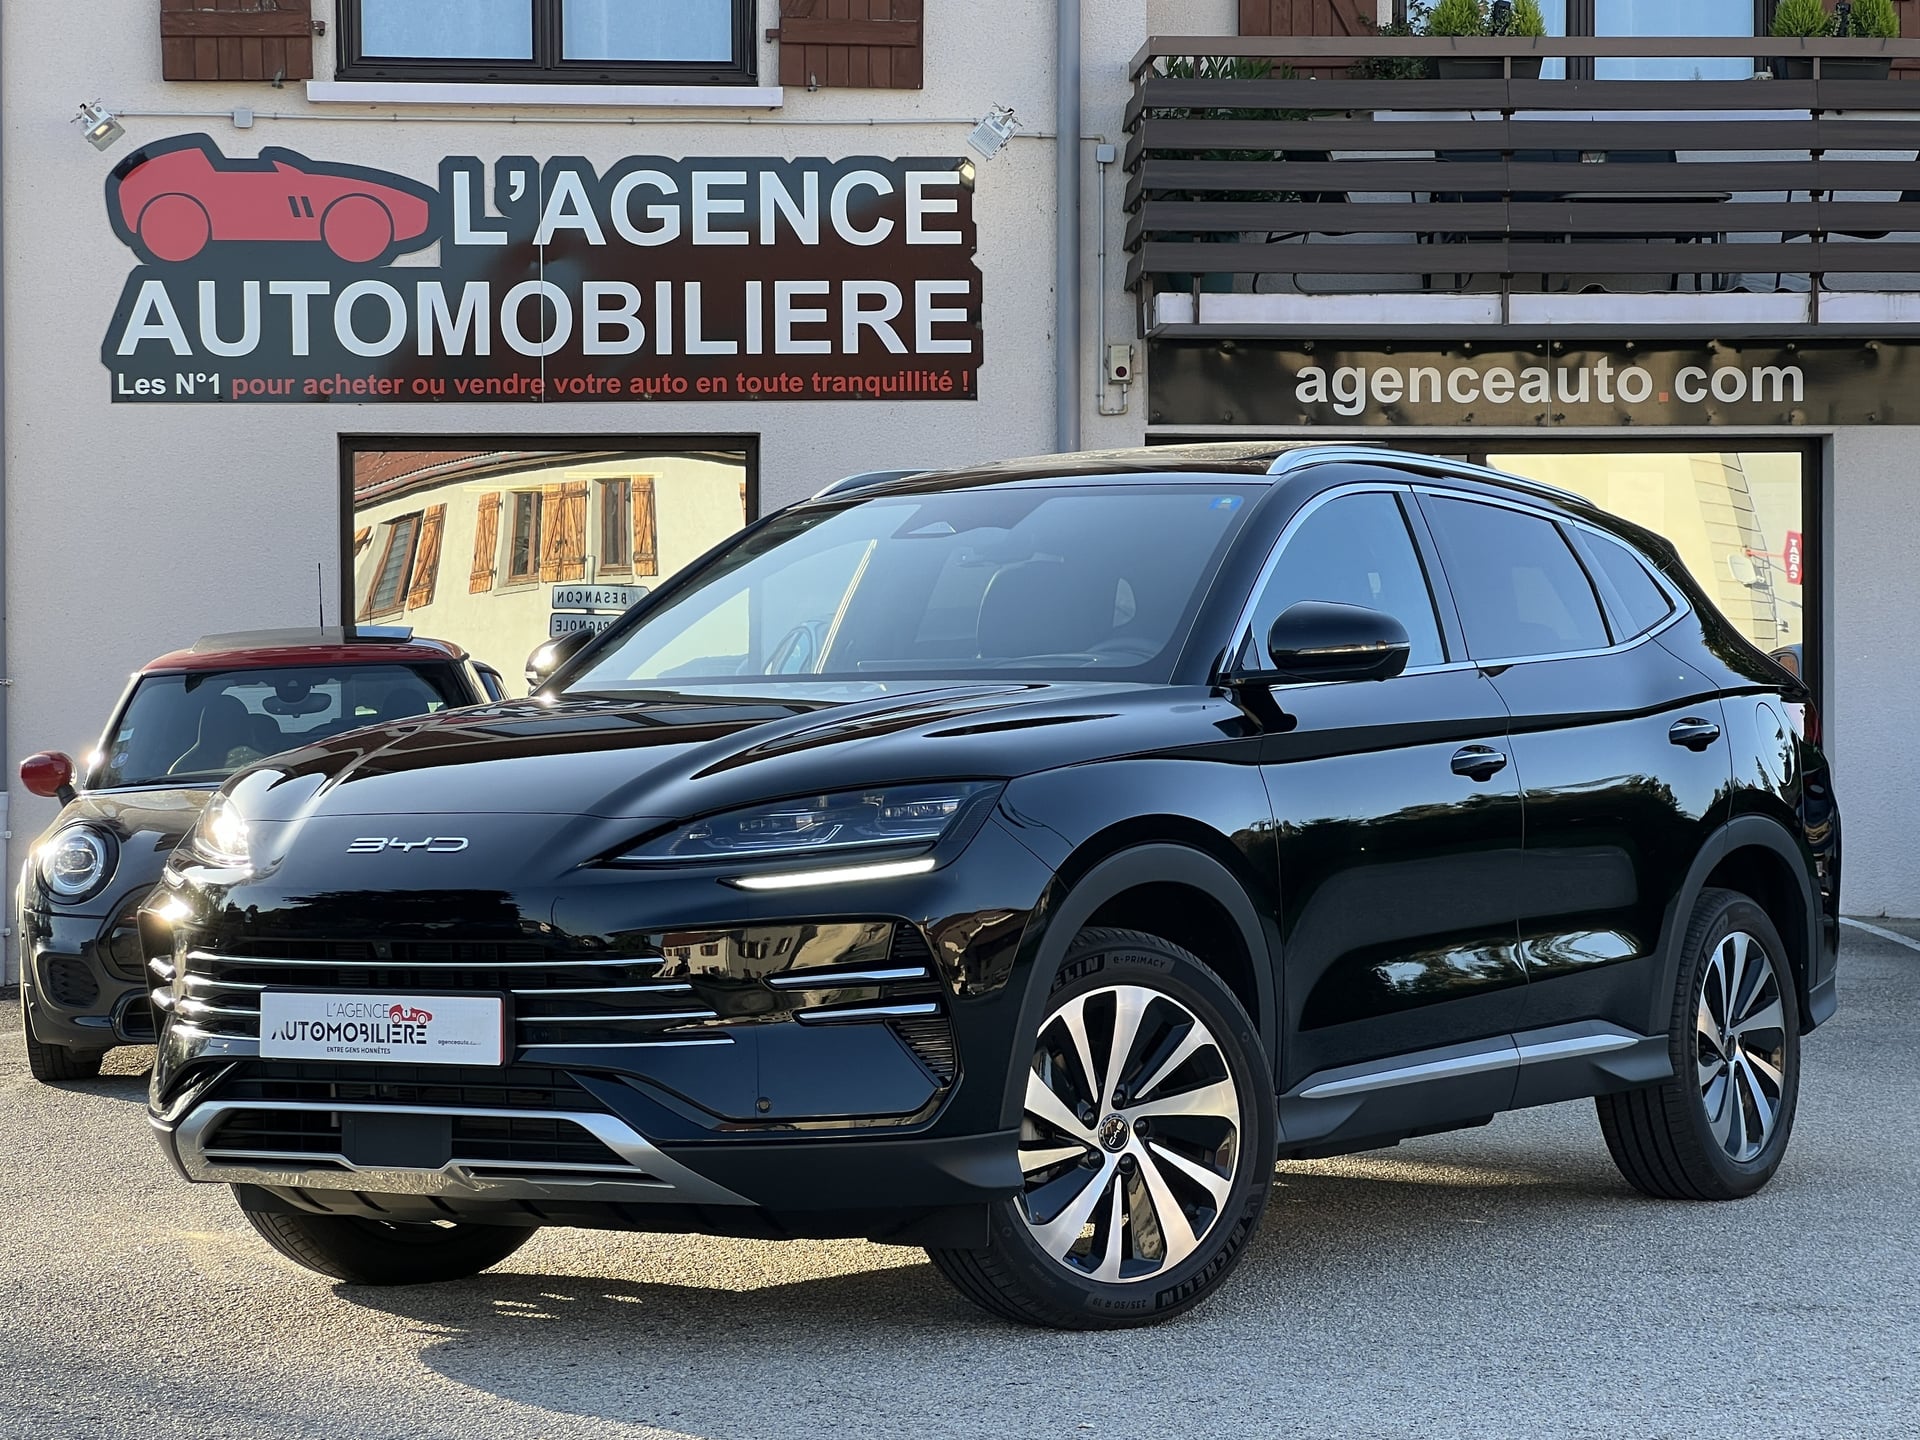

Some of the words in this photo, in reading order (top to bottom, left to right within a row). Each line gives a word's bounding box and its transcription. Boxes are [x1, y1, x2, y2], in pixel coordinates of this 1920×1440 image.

[116, 279, 972, 358] AUTOMOBILIERE
[118, 373, 167, 395] Les
[175, 373, 220, 395] N°1
[231, 376, 295, 400] pour
[302, 373, 404, 395] acheter
[412, 378, 446, 395] ou
[454, 372, 545, 395] vendre
[554, 376, 622, 394] votre
[629, 374, 689, 394] auto
[696, 376, 728, 393] en
[736, 373, 804, 393] toute
[812, 369, 954, 397] tranquillité
[1295, 356, 1805, 417] agenceauto.com
[346, 836, 470, 854] BYD
[1113, 955, 1166, 969] e-PRIMACY
[326, 1046, 344, 1054] ENTRE
[361, 1046, 391, 1055] HONNÊTES
[1161, 1222, 1248, 1308] MICHELIN
[1114, 1299, 1147, 1309] 235/50
